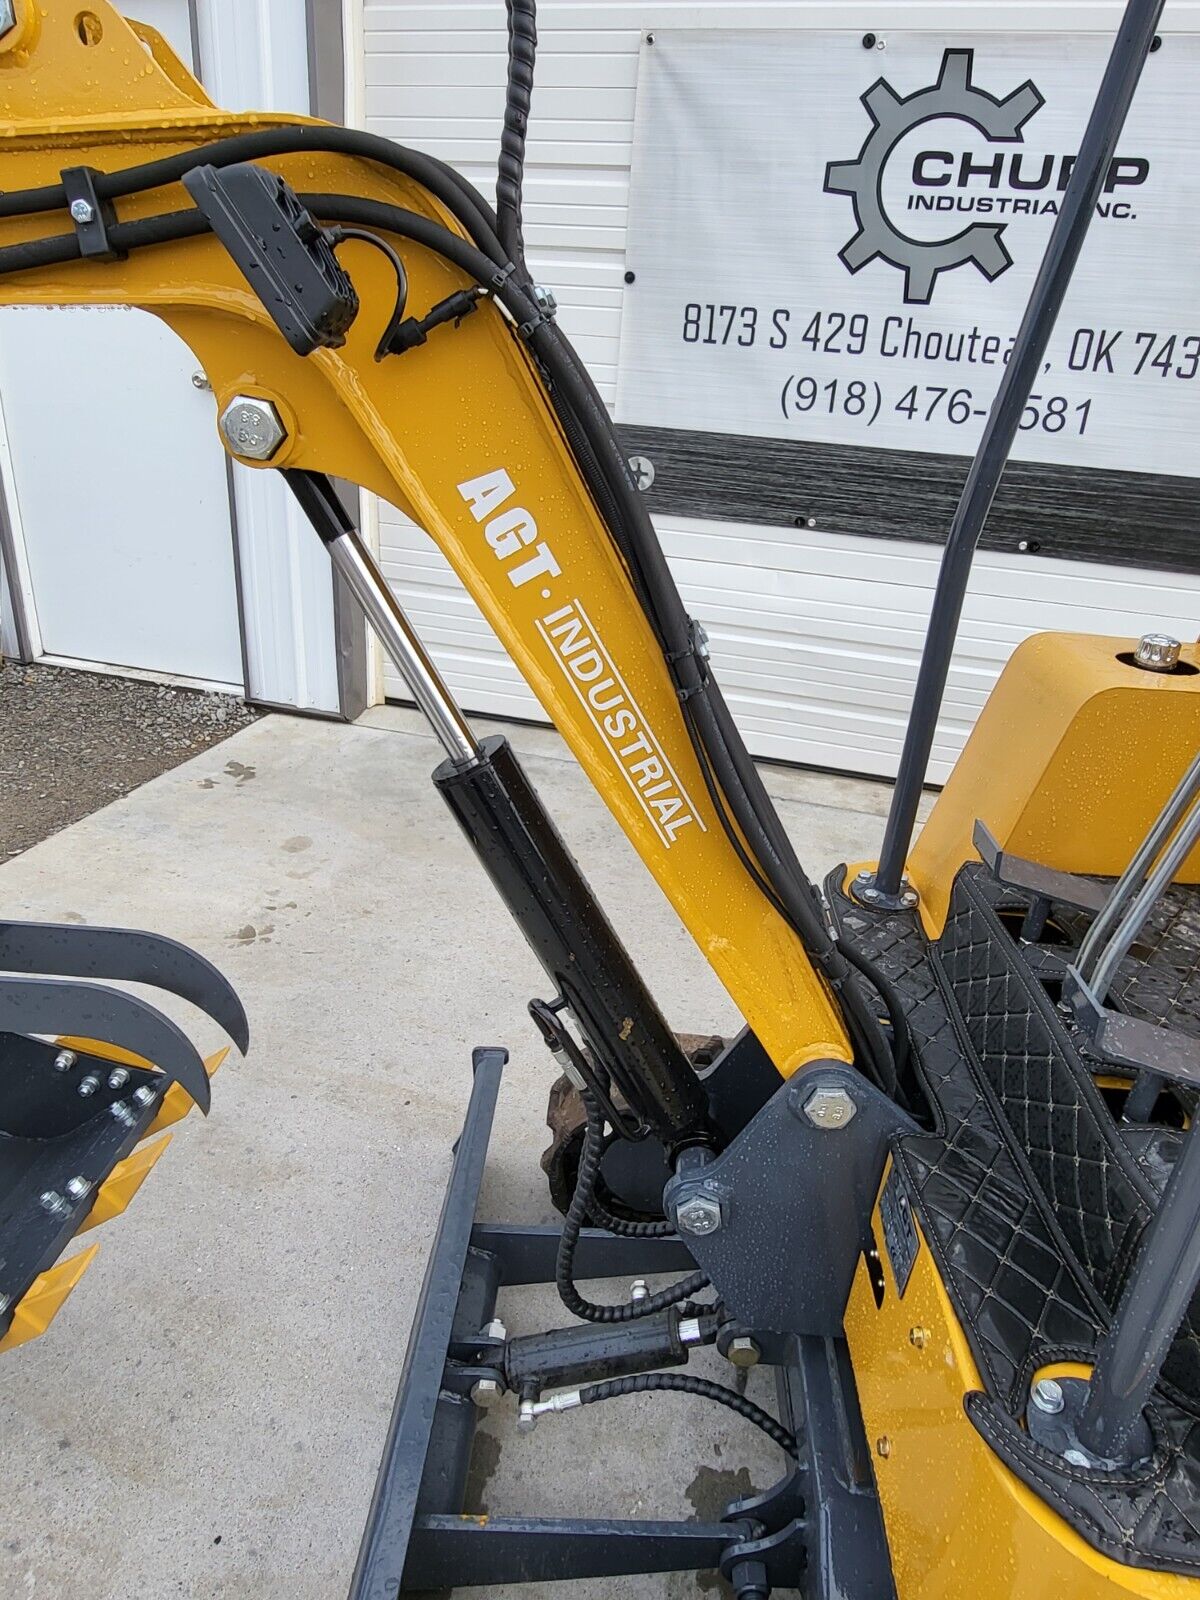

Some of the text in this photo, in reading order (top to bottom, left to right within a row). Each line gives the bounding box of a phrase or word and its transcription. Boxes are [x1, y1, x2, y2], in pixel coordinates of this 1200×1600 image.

[907, 195, 1137, 219] INDUSTRIA NC.
[683, 303, 758, 347] 8173
[769, 309, 790, 349] S
[802, 311, 869, 354] 429
[880, 315, 1051, 375] Choute,
[1068, 328, 1123, 374] OK
[781, 375, 1092, 435] (918) 476-581
[456, 468, 694, 843] AGT INDUSTRIAL
